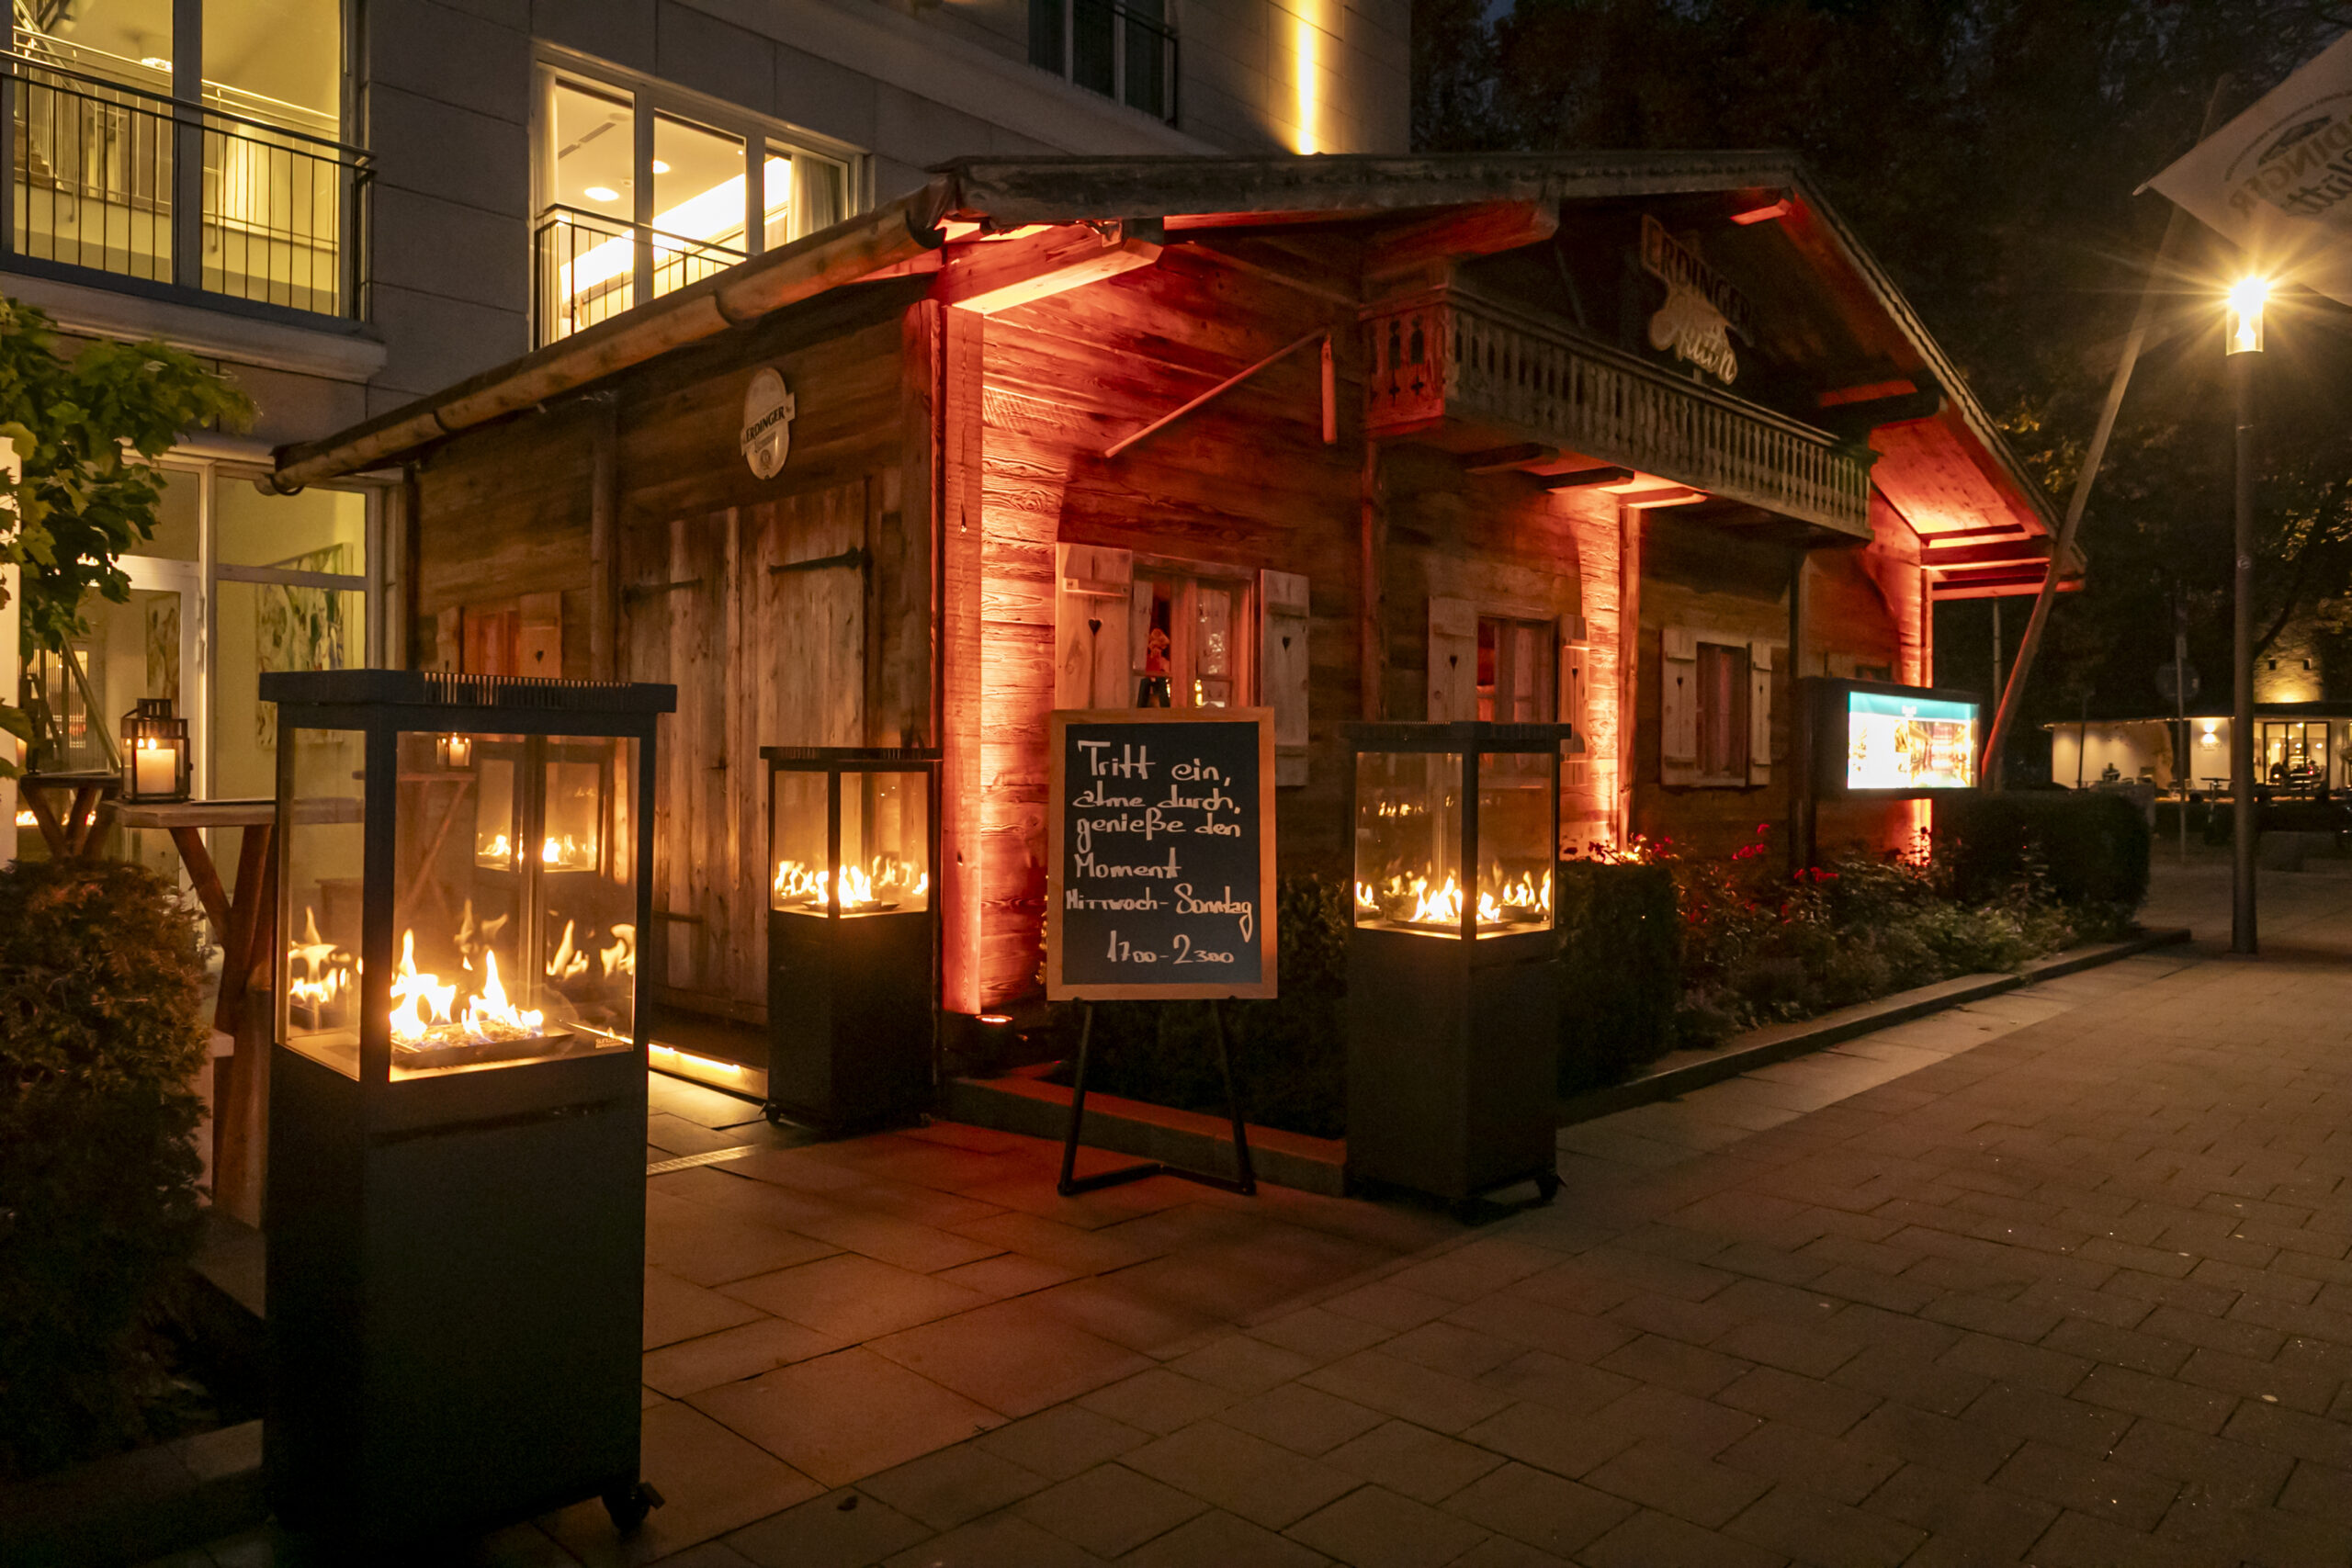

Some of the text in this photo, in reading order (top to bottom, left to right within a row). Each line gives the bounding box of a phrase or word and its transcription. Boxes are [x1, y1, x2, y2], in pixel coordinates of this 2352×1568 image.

[745, 406, 786, 442] ERDINGER
[1078, 739, 1231, 786] Tritt ein,
[1072, 780, 1240, 815] atme durch,
[1077, 807, 1240, 854] genieße den
[1074, 847, 1182, 879] Moment
[1174, 883, 1253, 943] Sonntag
